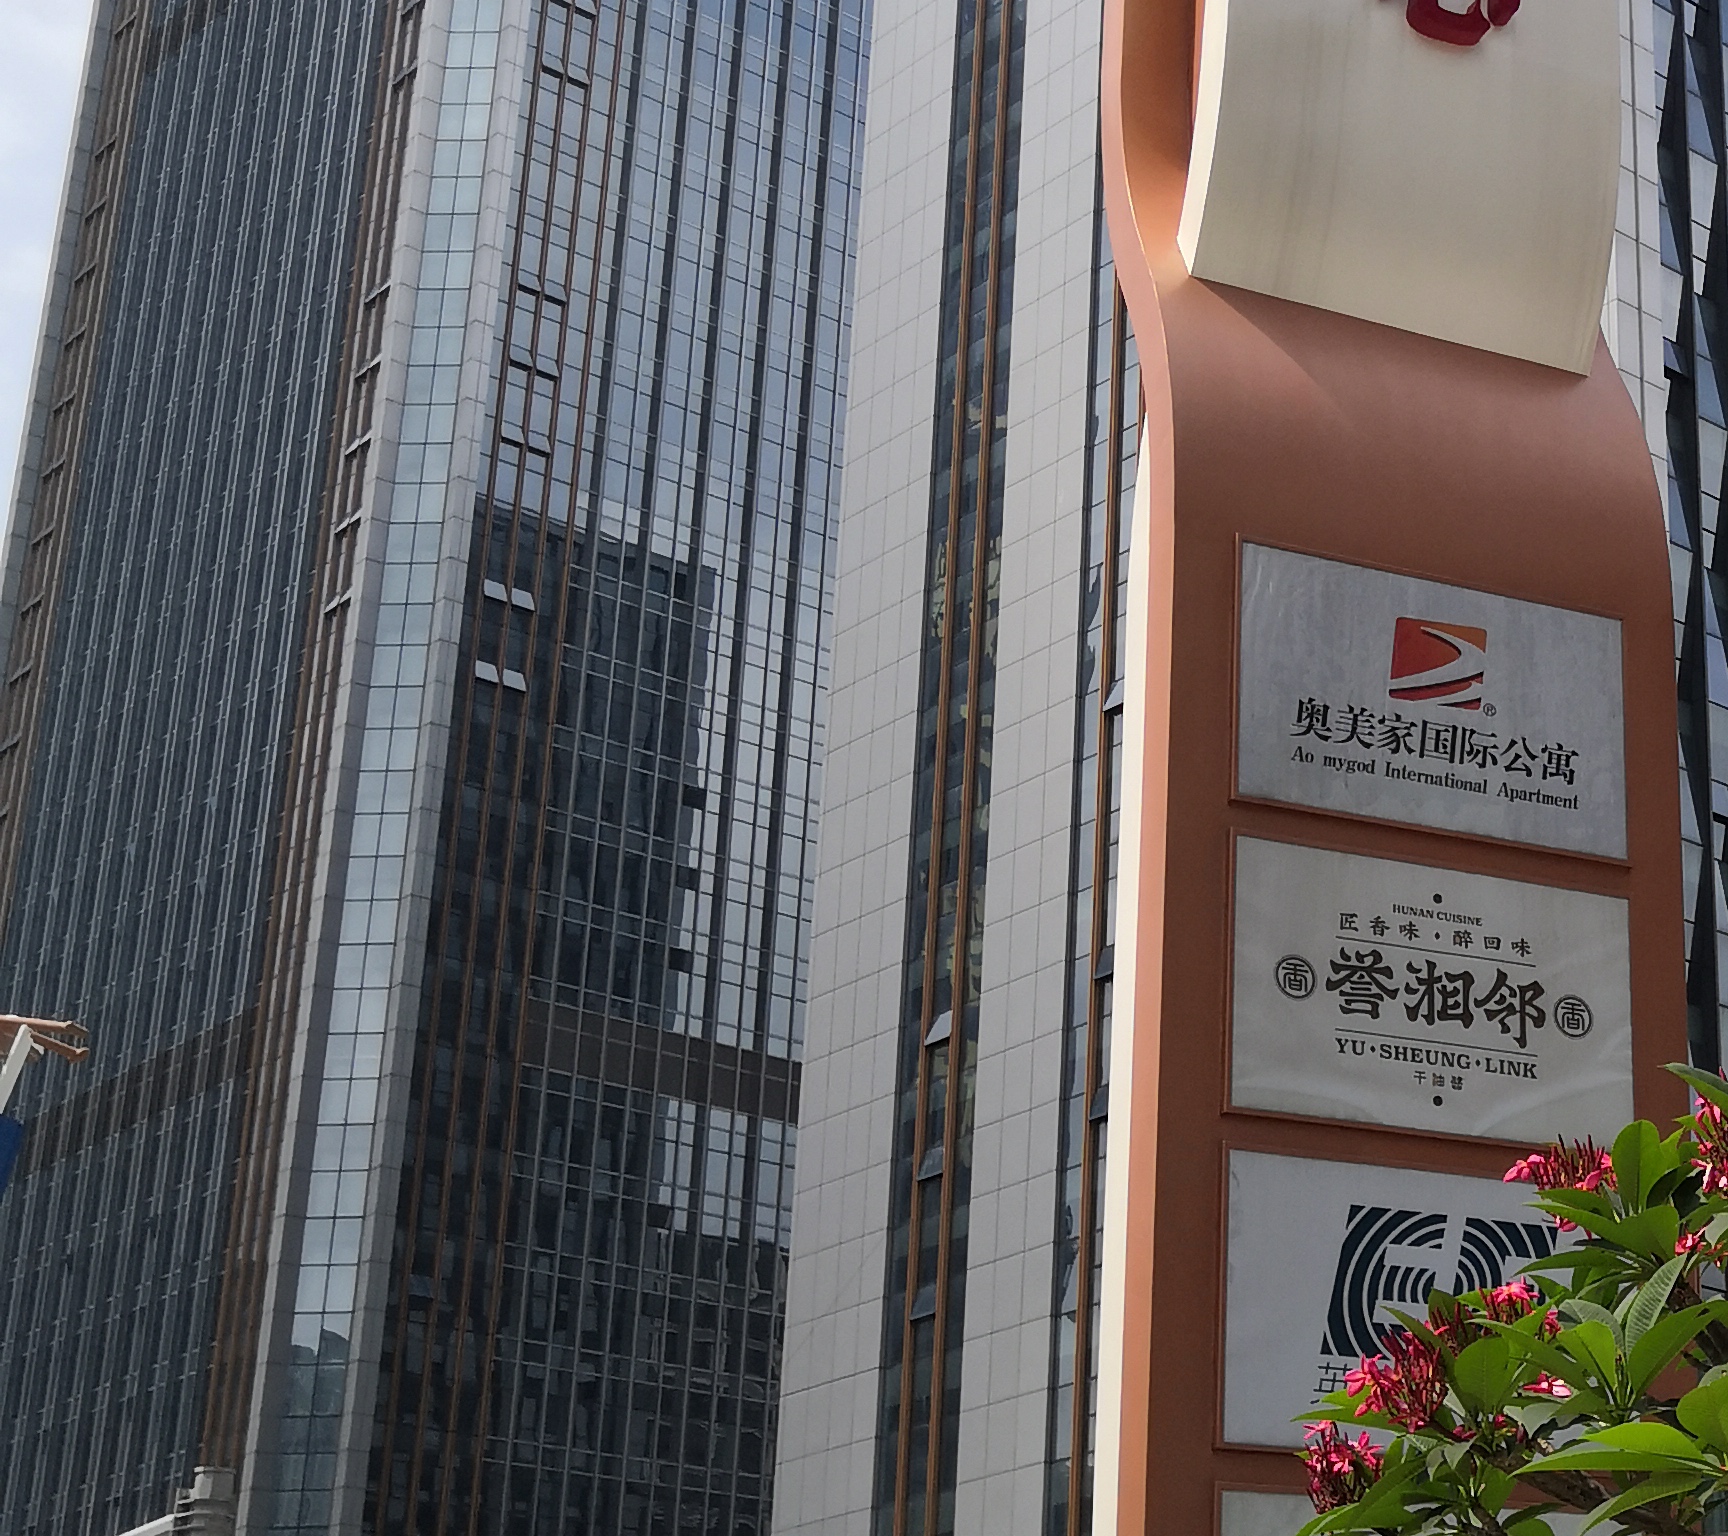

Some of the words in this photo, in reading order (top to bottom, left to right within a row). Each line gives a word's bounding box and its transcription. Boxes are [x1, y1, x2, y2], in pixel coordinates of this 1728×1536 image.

[1290, 697, 1579, 785] 奥美家国际公寓
[1290, 745, 1315, 764] Ao
[1322, 752, 1376, 776] mygod
[1383, 762, 1488, 795] International
[1496, 781, 1579, 810] Apartment
[1392, 903, 1434, 920] HUNAN
[1436, 911, 1483, 927] CUISINE
[1325, 946, 1547, 1049] 誉湘邻
